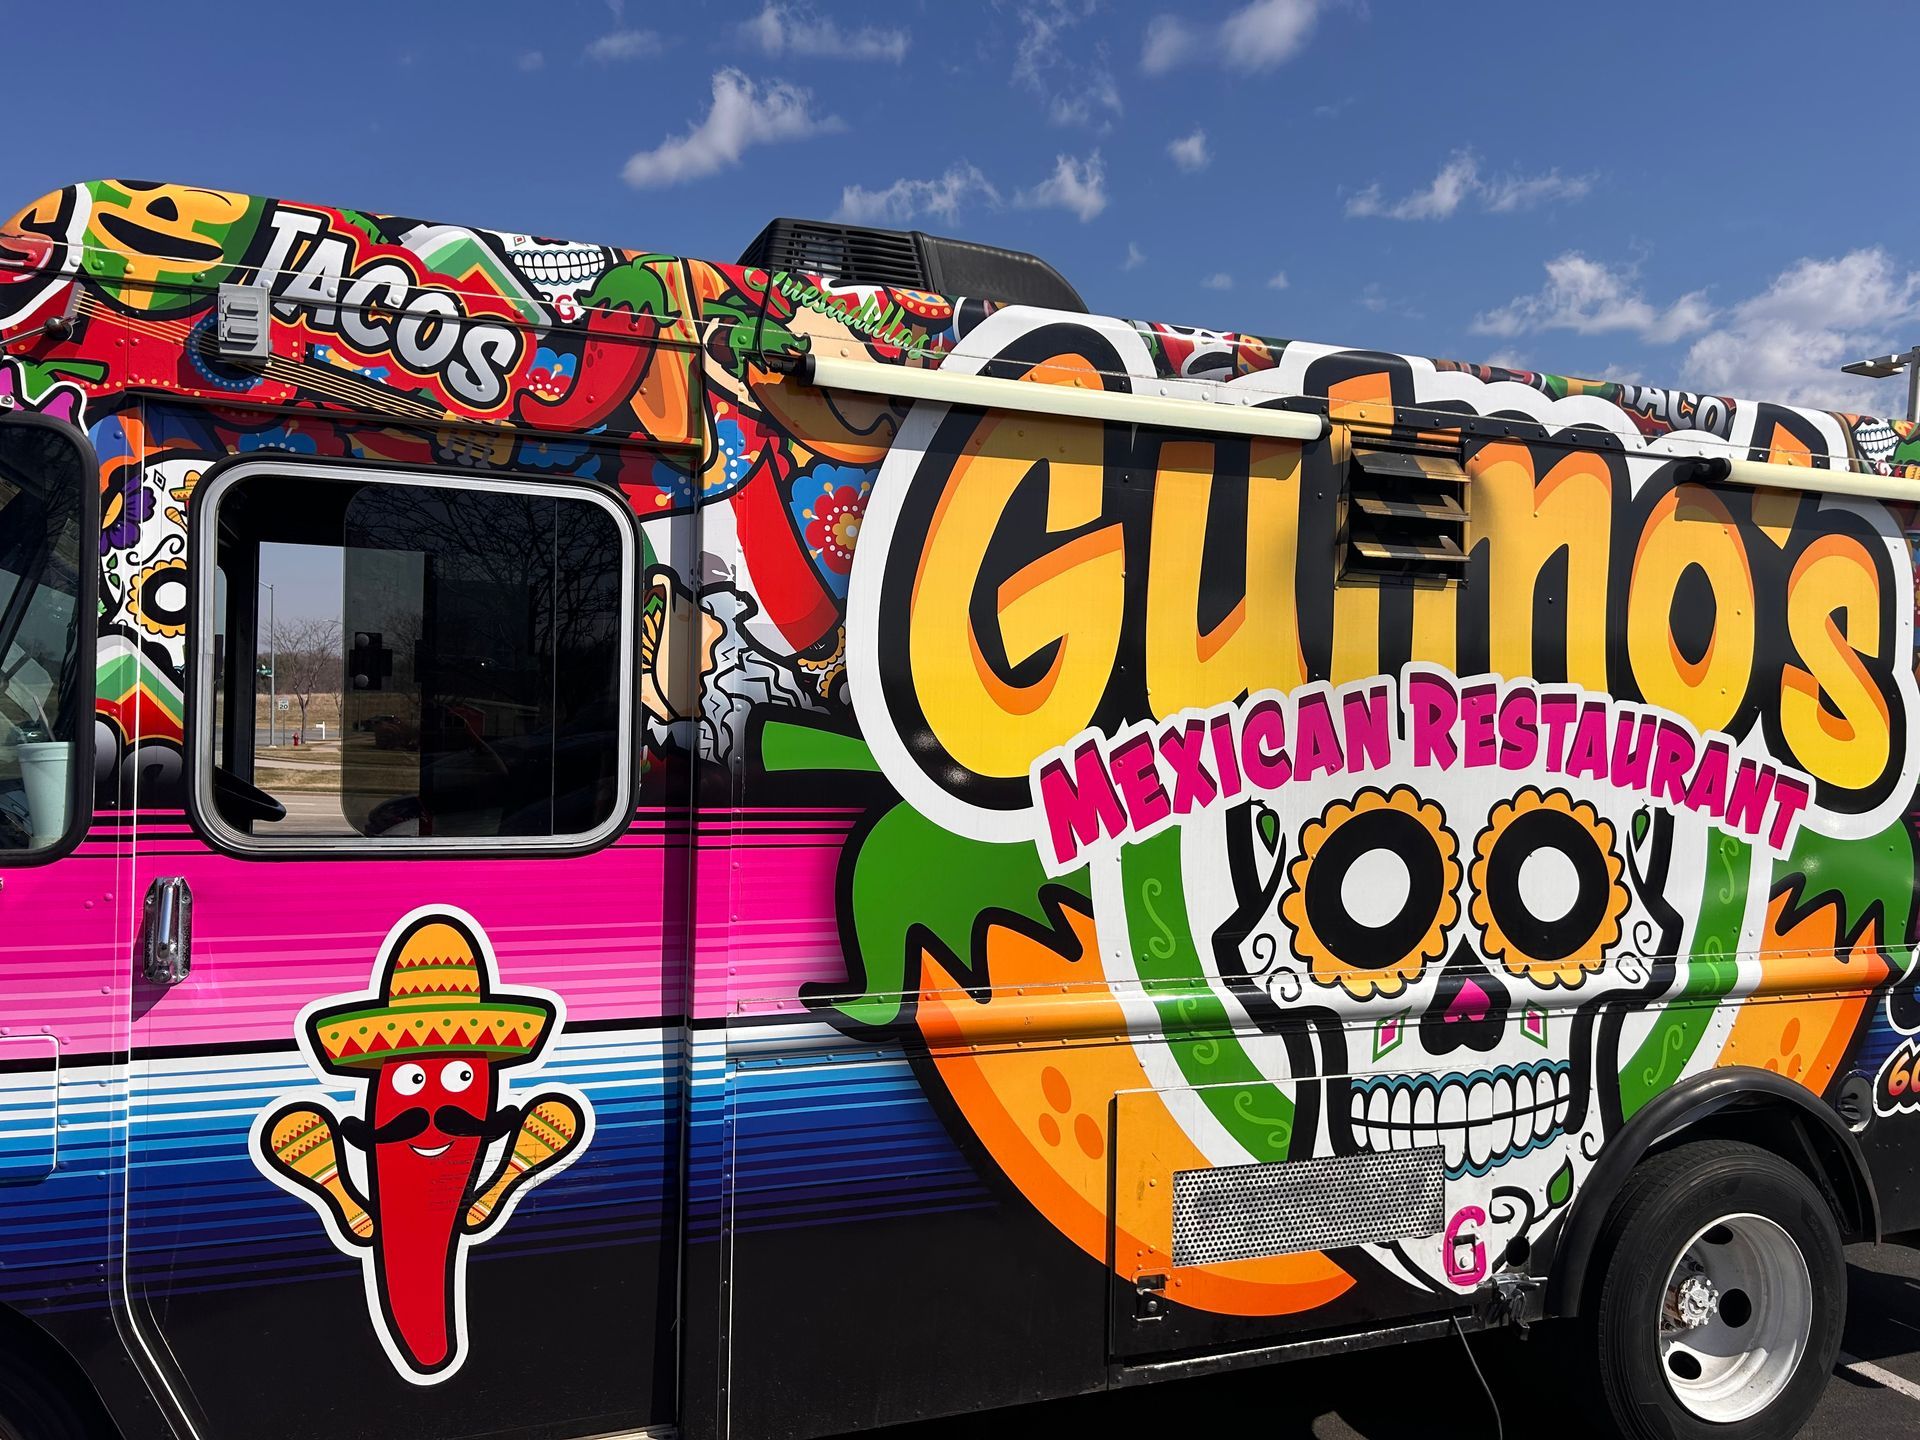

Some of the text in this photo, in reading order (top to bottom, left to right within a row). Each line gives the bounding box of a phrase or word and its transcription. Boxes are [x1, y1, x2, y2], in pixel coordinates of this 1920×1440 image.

[250, 210, 517, 403] TACOS
[744, 267, 945, 359] Quesadillas
[1622, 384, 1736, 436] ACO
[1041, 671, 1809, 864] MEXICAN RESTAURANT
